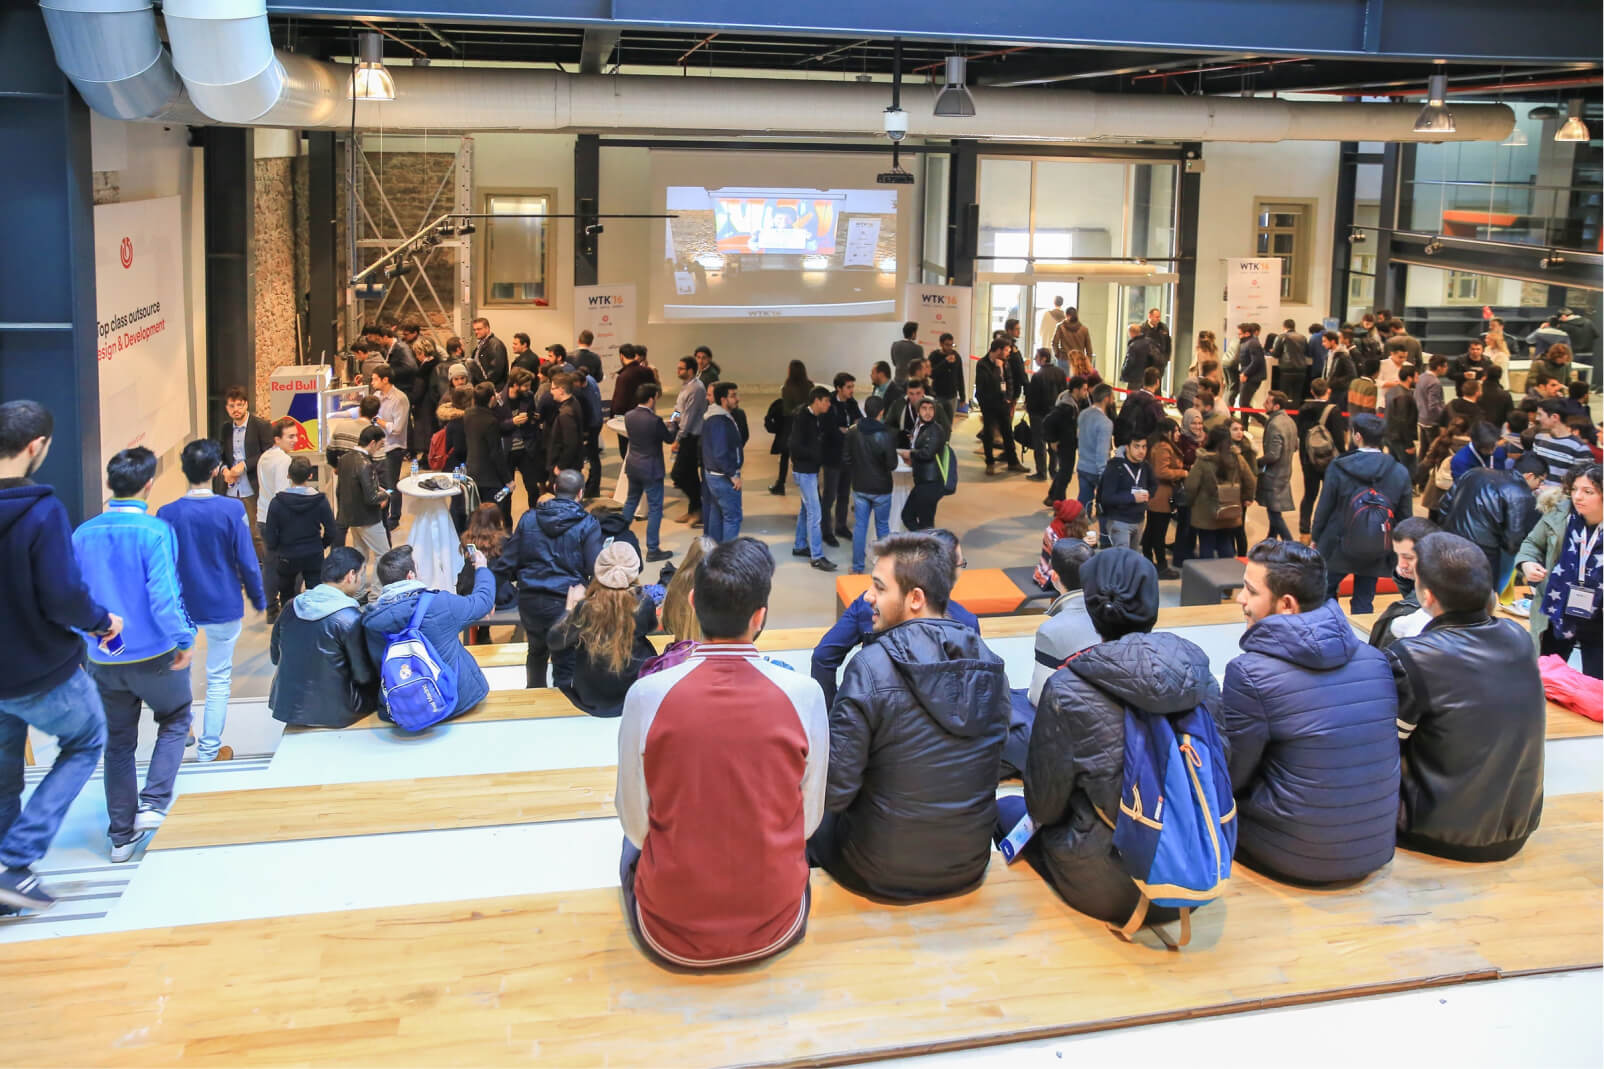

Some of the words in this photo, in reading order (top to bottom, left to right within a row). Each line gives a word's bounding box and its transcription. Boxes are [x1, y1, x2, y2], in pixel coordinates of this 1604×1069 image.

[110, 313, 128, 332] class
[128, 301, 160, 324] outsource
[97, 341, 117, 361] esign
[117, 335, 123, 352] &
[124, 319, 165, 349] Development
[271, 379, 294, 391] Red
[295, 378, 317, 391] Bull
